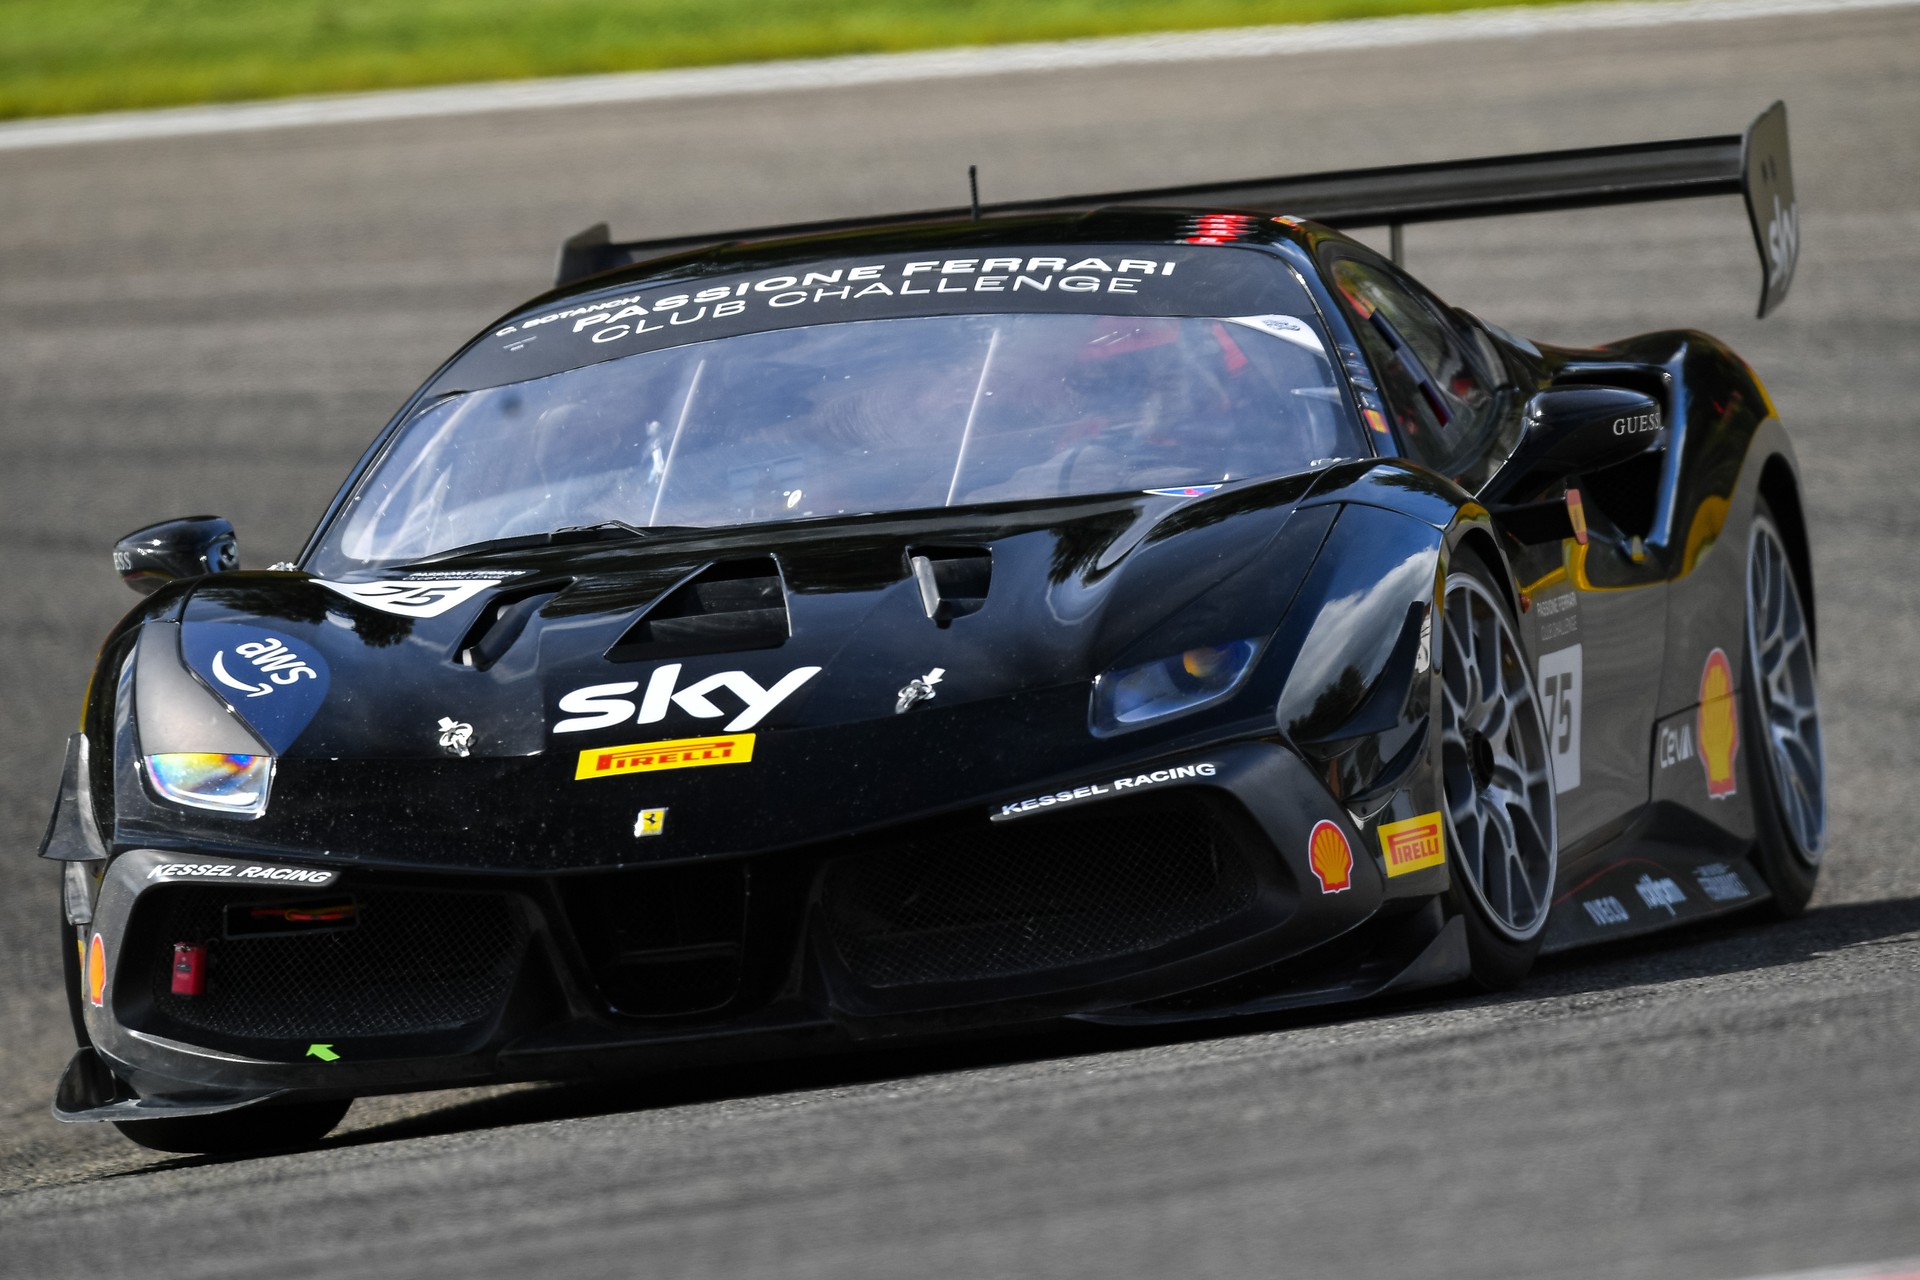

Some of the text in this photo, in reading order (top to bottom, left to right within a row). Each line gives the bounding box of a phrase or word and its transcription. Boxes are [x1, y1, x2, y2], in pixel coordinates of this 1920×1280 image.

[572, 257, 1176, 333] PASSIONE FERRARI
[591, 274, 1142, 344] CLUB CHALLENGE
[236, 637, 318, 686] aws
[552, 663, 823, 733] sky
[1544, 671, 1573, 756] 75
[595, 741, 737, 772] PIRELLI
[1002, 763, 1217, 816] KESSEL RACING
[1387, 823, 1440, 866] PIRELLI
[147, 863, 332, 884] KESSEL RACING
